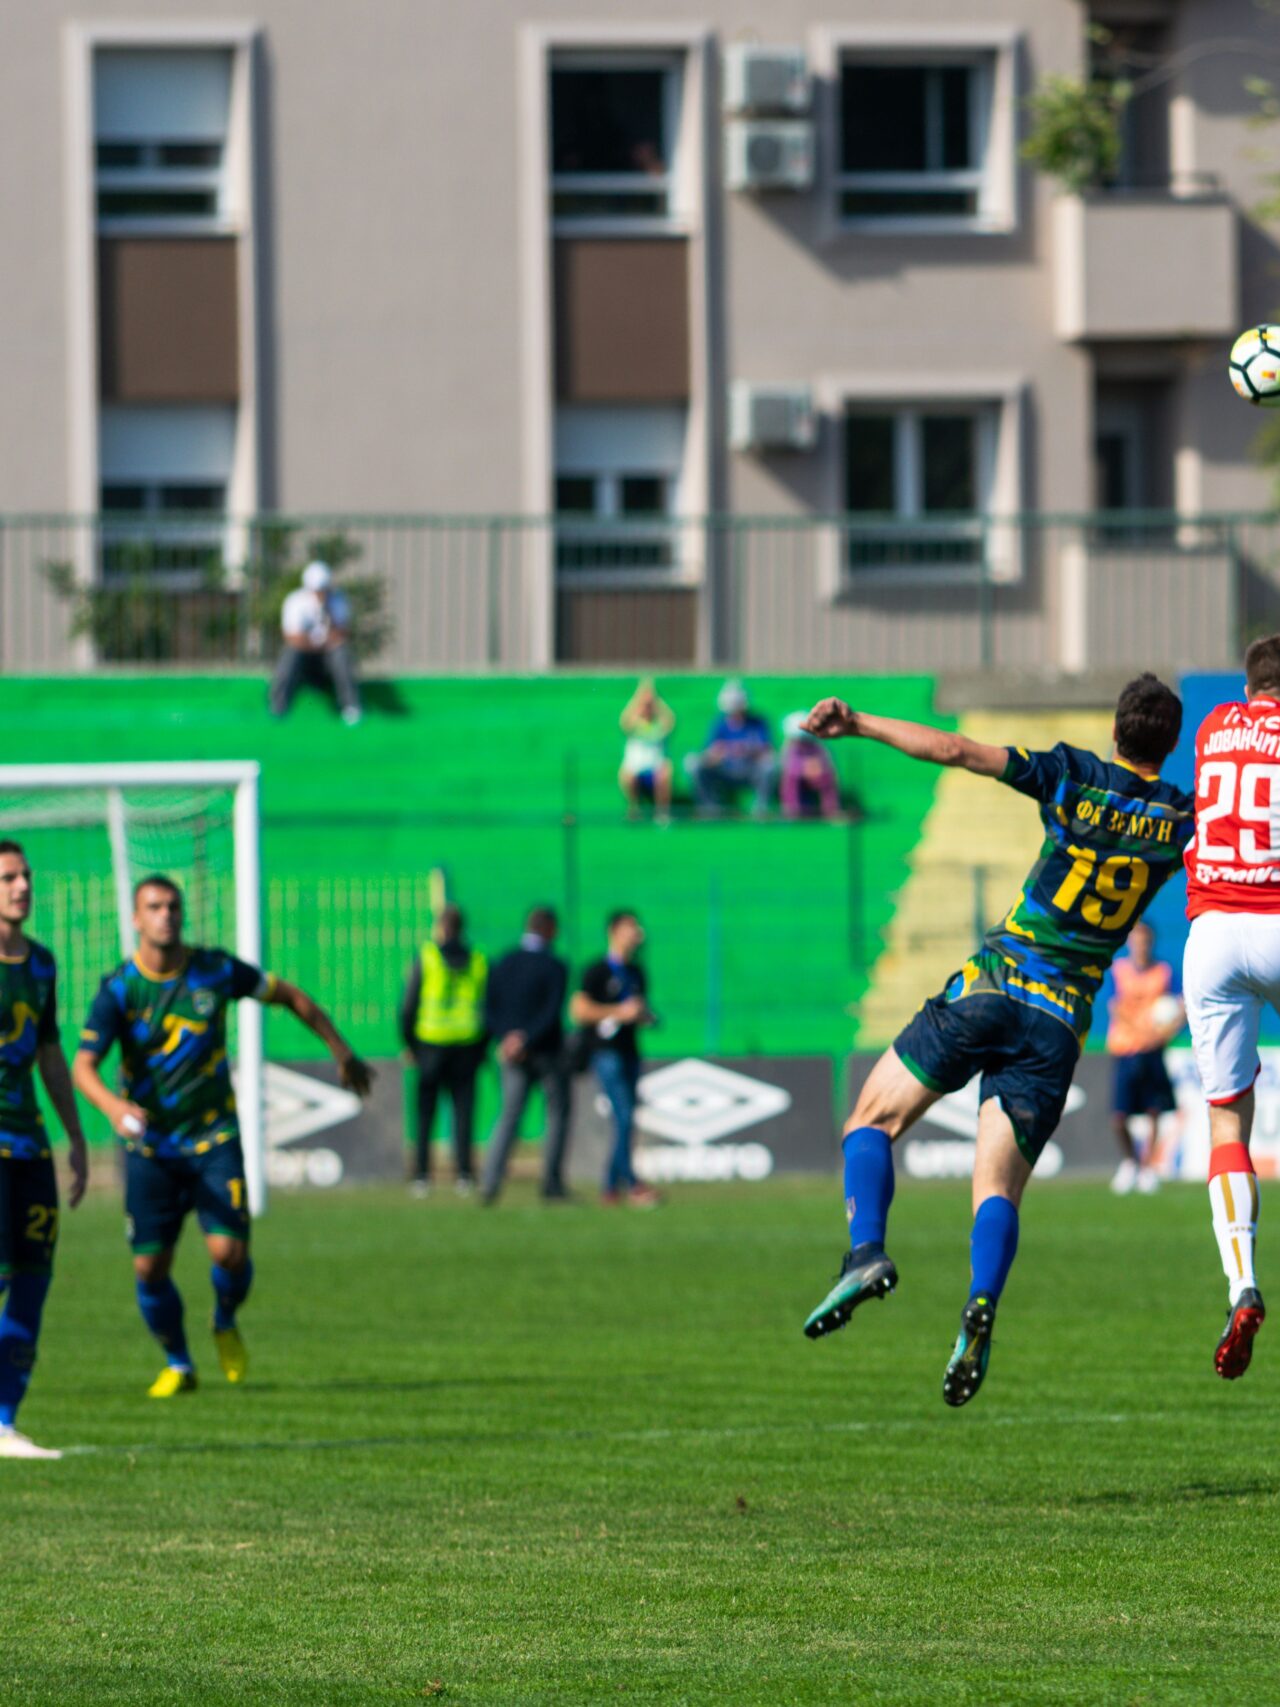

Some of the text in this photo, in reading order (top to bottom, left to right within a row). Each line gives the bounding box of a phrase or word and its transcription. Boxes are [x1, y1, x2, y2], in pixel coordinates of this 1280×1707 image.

[1076, 799, 1173, 843] ФК ЗЕМУН
[1052, 844, 1149, 931] 19
